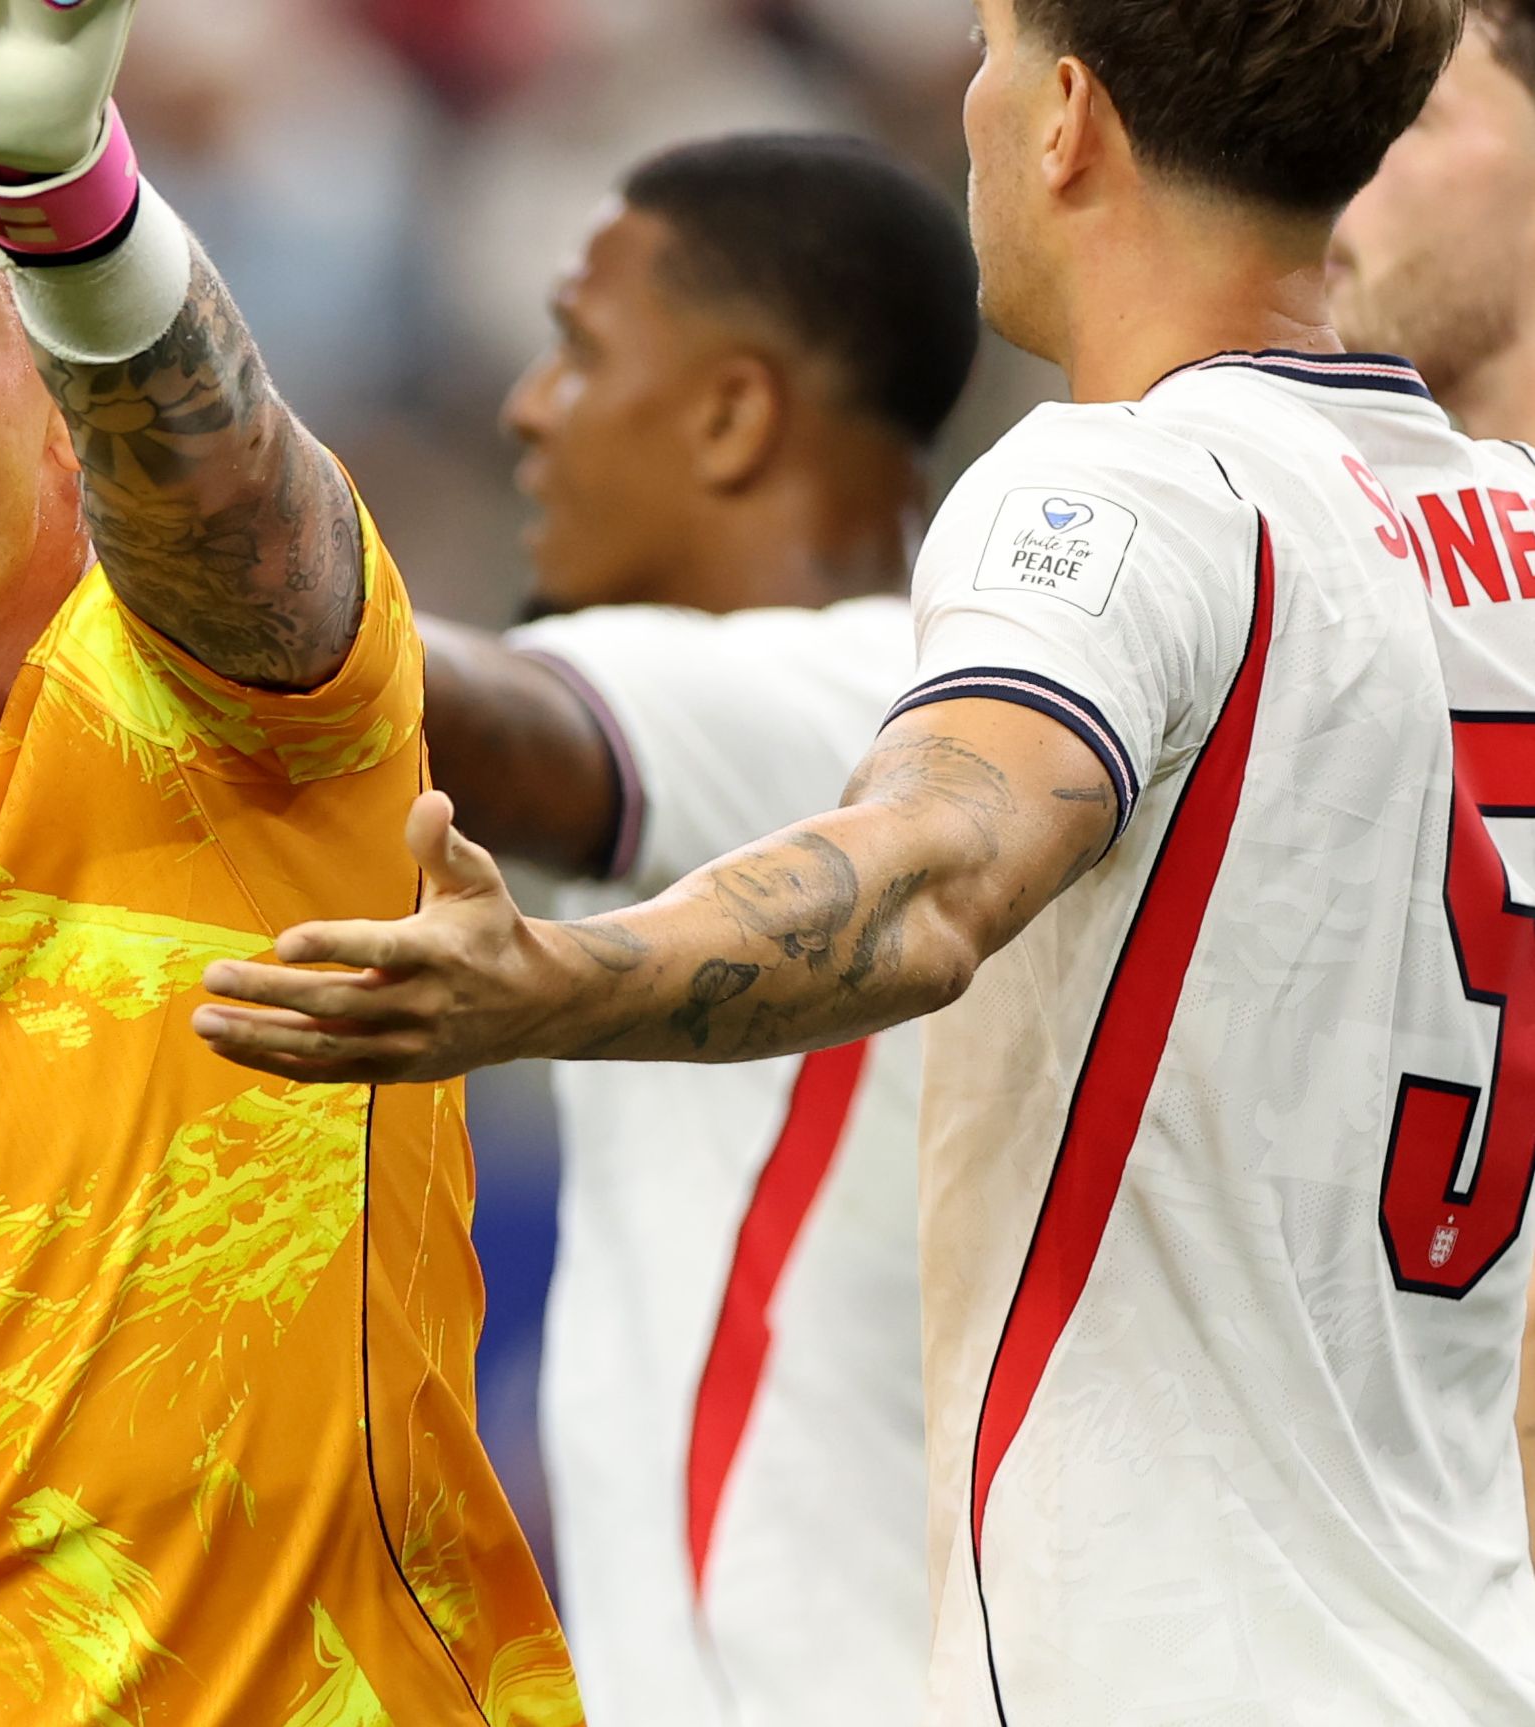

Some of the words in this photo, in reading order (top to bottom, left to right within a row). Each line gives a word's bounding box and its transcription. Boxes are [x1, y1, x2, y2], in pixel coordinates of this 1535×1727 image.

[1013, 529, 1062, 551] Unite
[1066, 539, 1093, 559] For
[1341, 454, 1535, 608] SNE
[1011, 550, 1083, 580] PEACE
[1020, 573, 1057, 588] FIFA
[1379, 710, 1535, 1300] 5
